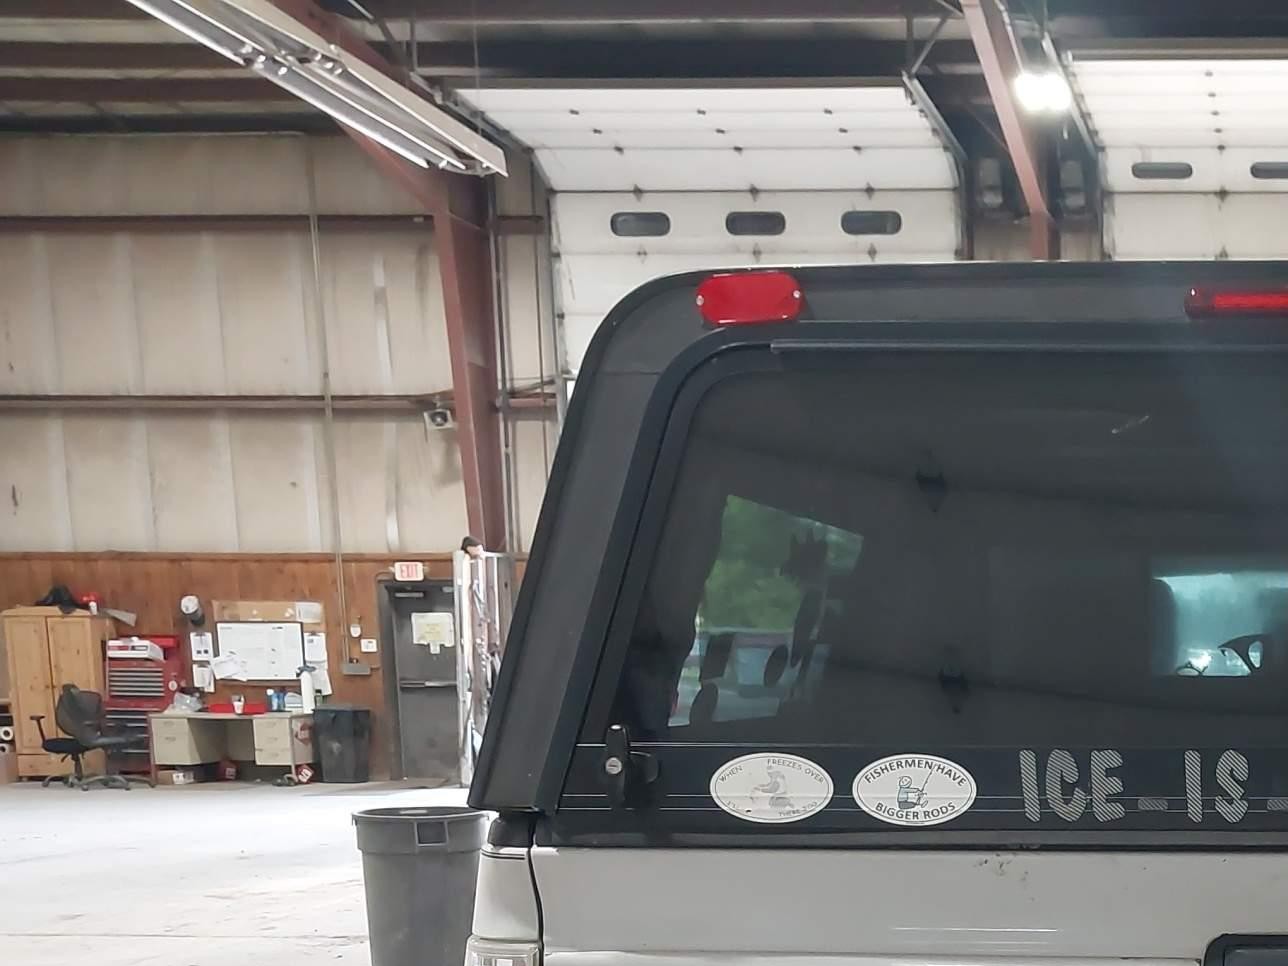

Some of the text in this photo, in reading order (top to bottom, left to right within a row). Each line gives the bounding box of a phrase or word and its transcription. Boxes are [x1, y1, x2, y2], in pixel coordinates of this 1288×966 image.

[719, 758, 824, 783] WHEN FREEZES OVER
[864, 759, 967, 788] FISHERMEN HAVE
[875, 802, 956, 820] BIGGER RODS
